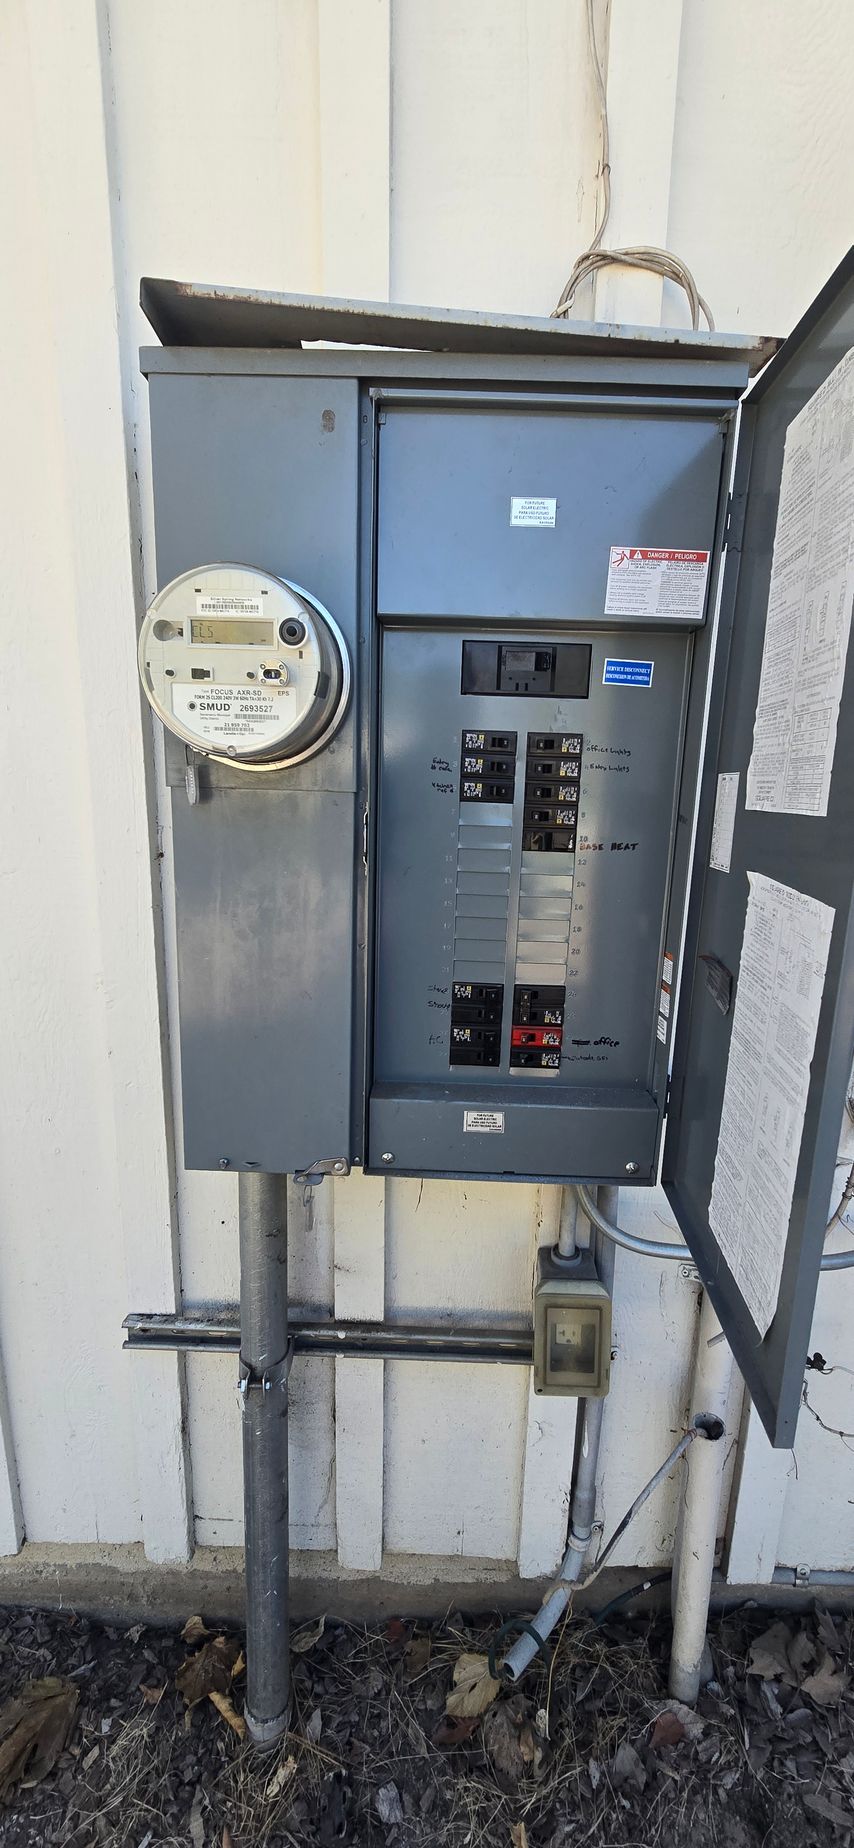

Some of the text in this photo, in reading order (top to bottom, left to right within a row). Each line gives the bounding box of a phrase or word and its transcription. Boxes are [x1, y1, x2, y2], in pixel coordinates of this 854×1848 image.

[199, 703, 230, 711] SMUD
[611, 842, 639, 851] HEAT
[594, 1036, 620, 1047] office
